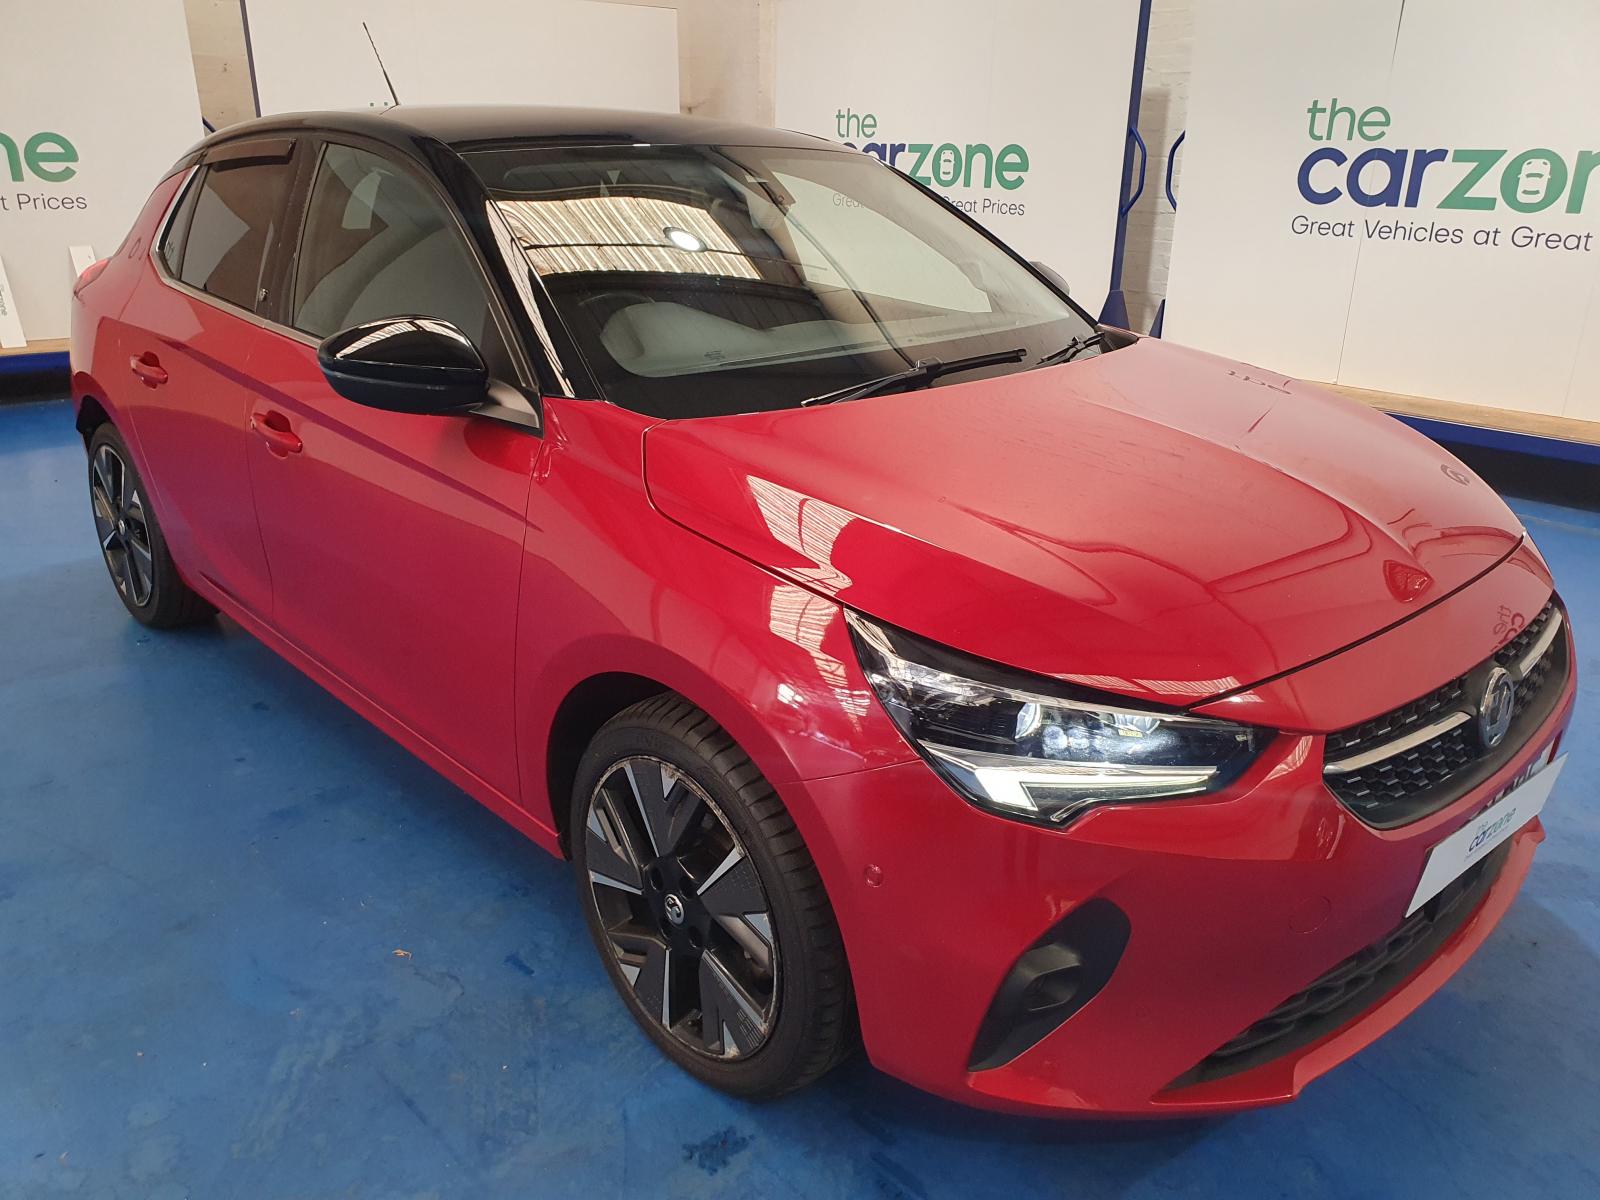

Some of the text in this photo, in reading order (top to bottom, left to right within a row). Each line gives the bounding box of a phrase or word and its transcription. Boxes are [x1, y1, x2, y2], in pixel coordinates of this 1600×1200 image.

[836, 108, 877, 138] the
[1307, 98, 1391, 141] the
[17, 193, 87, 210] Prices
[983, 198, 1025, 216] Prices
[1291, 215, 1593, 252] Great Vehicles at Great
